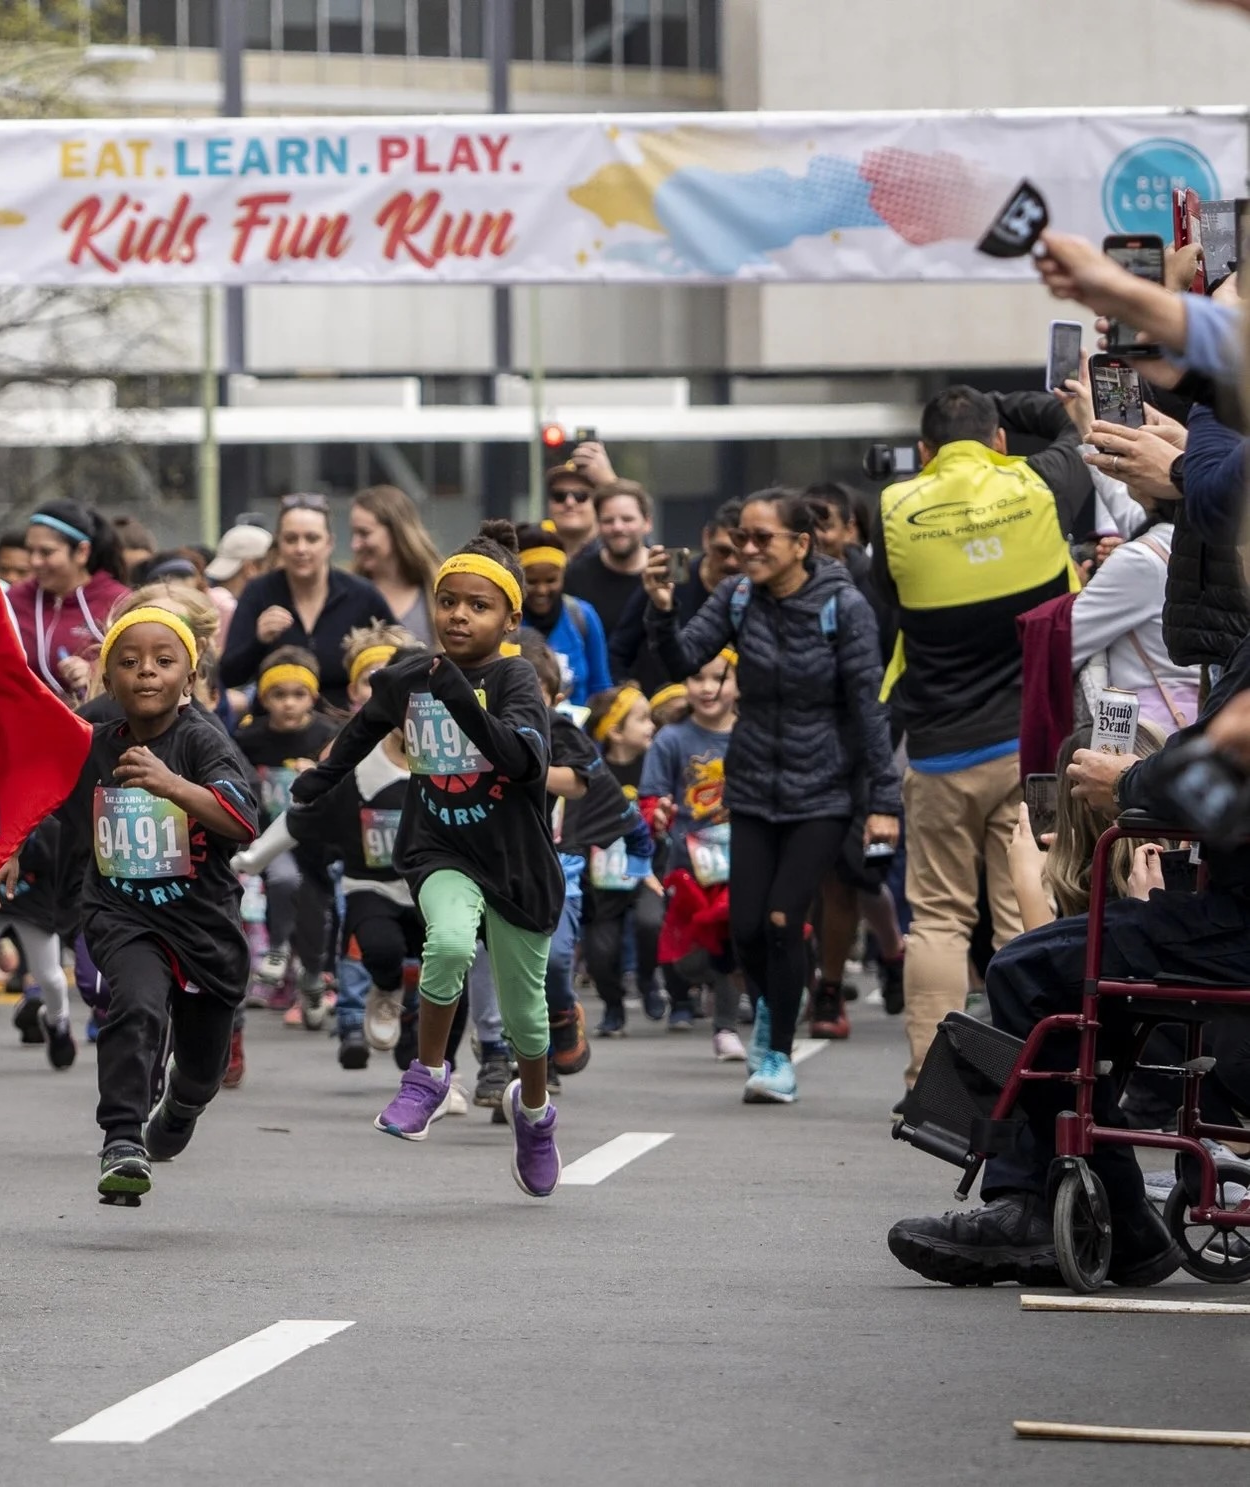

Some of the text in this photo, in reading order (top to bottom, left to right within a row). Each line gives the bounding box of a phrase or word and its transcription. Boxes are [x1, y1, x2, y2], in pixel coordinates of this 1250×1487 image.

[1120, 193, 1171, 212] LOC
[60, 189, 516, 274] Kids Fun Run
[909, 508, 1034, 542] OFFICIAL PHOTOGRAPHER
[962, 535, 1004, 565] 133
[1098, 716, 1131, 734] Death
[1099, 701, 1133, 721] Liquid
[97, 815, 183, 861] 9491
